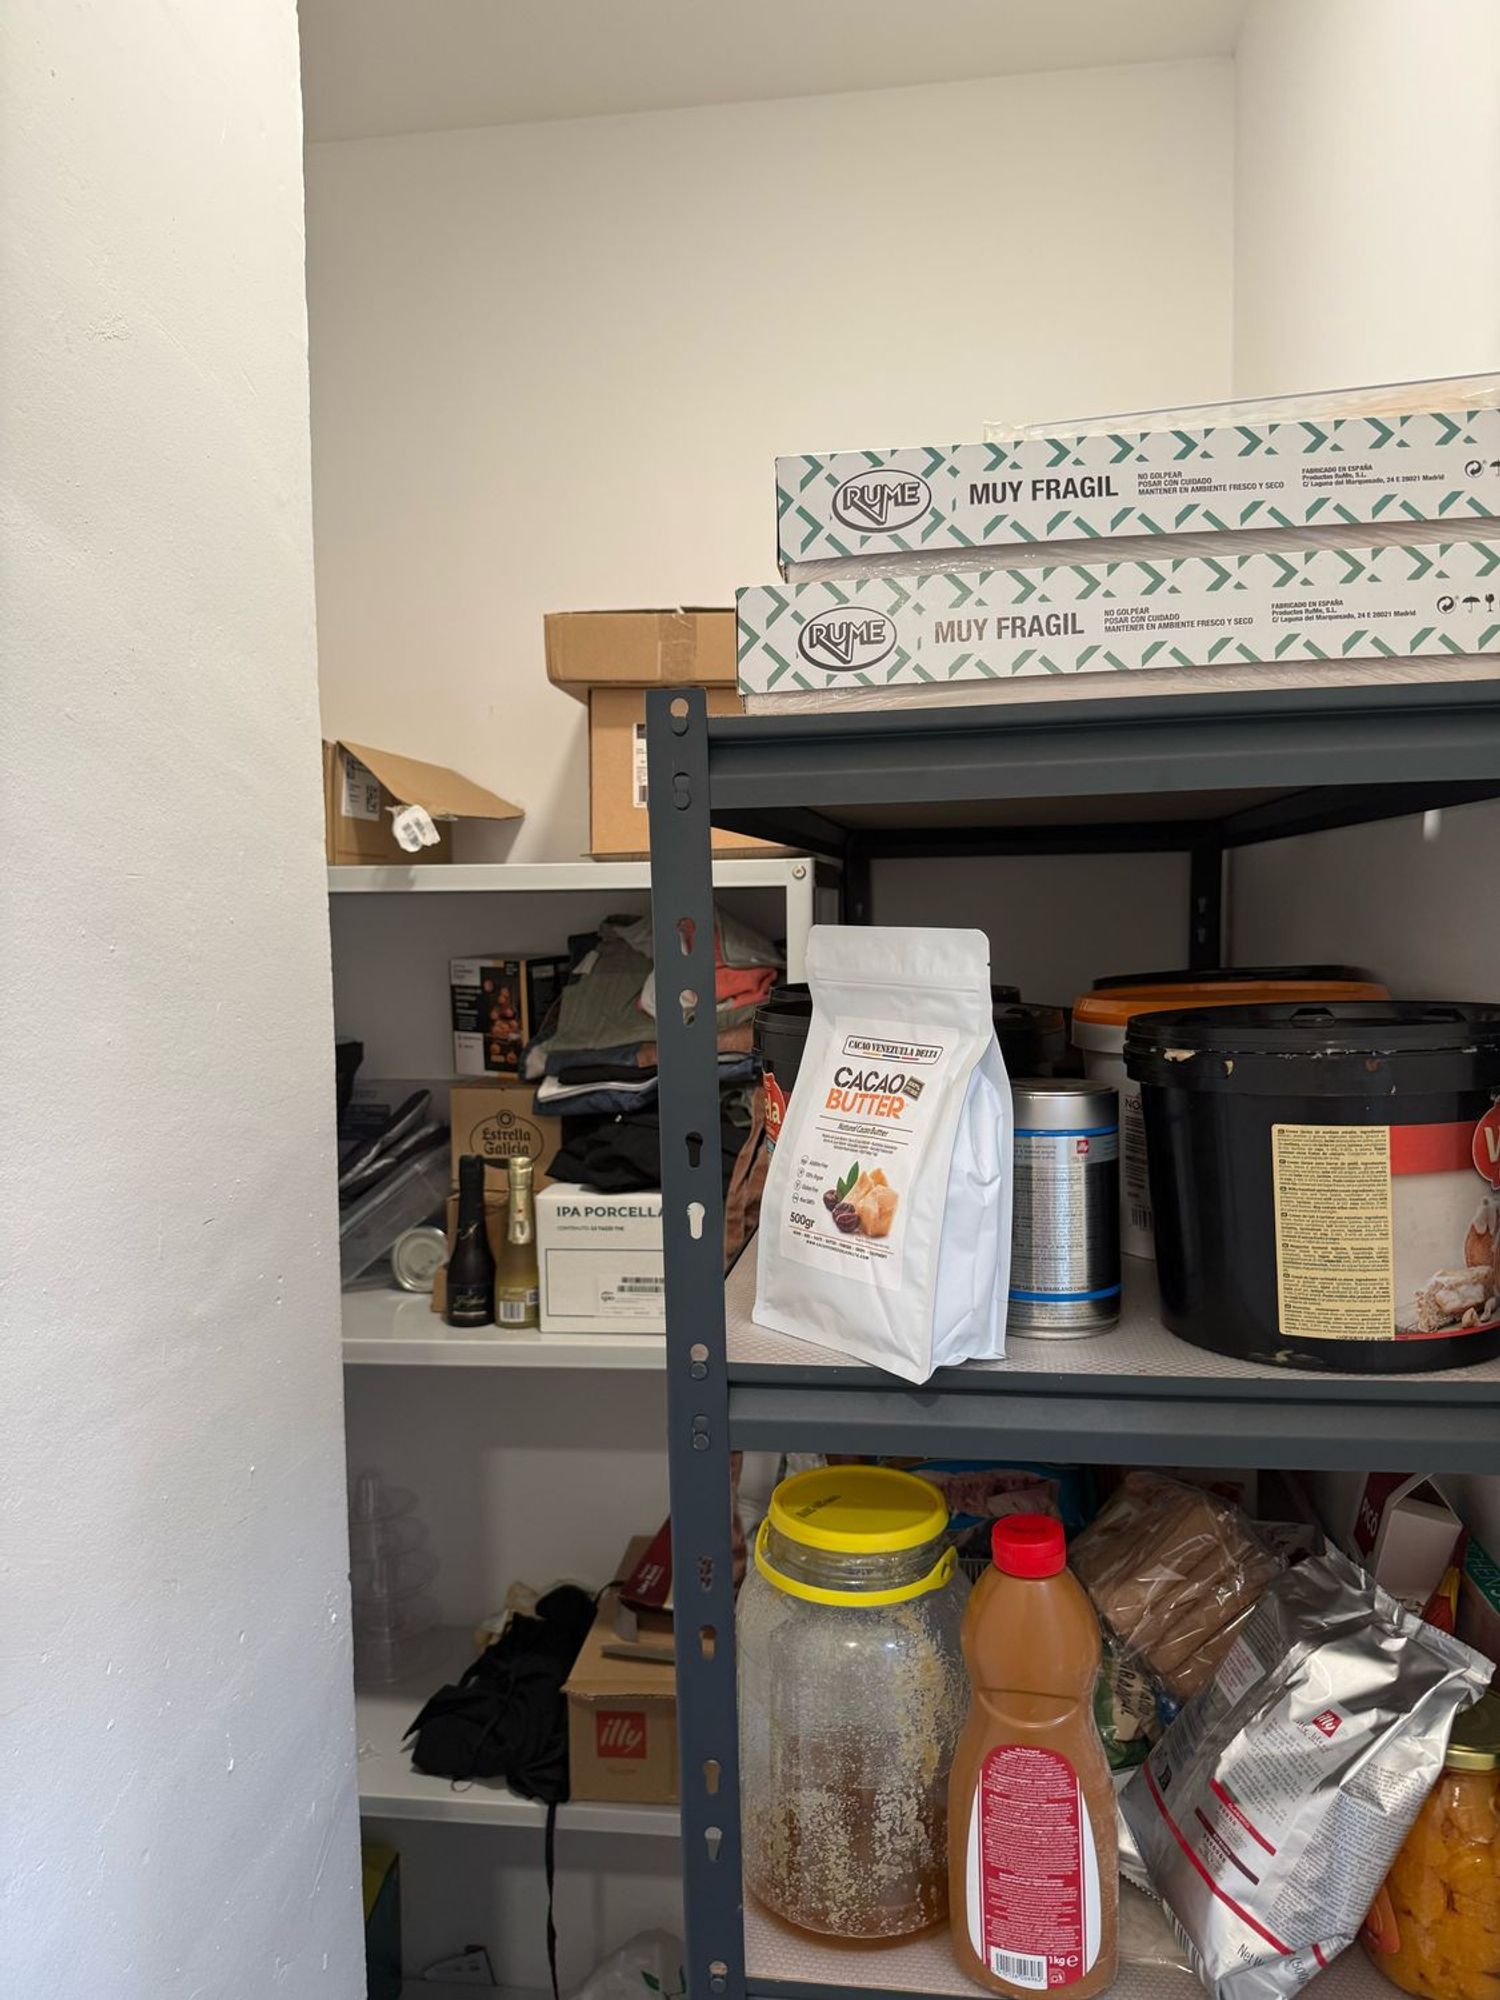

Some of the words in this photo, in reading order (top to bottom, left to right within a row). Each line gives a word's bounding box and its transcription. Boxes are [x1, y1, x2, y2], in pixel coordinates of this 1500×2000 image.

[1137, 480, 1162, 488] POSAR
[1163, 479, 1179, 487] CON
[1180, 477, 1212, 486] CUIDADO
[1149, 471, 1182, 480] GOLPEAR
[969, 480, 1023, 505] MUY
[1031, 475, 1119, 502] FRAGIL
[1138, 487, 1178, 496] MANTENER
[1179, 486, 1189, 494] EN
[1190, 484, 1228, 493] AMBIENTE
[1228, 482, 1257, 491] FRESCO
[1265, 481, 1285, 490] SECO
[842, 481, 920, 526] RUME
[1103, 609, 1115, 617] NO
[1116, 606, 1150, 615] GOLPEAR
[1271, 601, 1307, 609] FABRICADO
[1308, 600, 1317, 608] EN
[1318, 598, 1344, 607] ESPAÑA
[1104, 616, 1129, 625] POSAR
[1130, 615, 1146, 623] CON
[1147, 613, 1180, 622] CUIDADO
[1104, 624, 1145, 633] MANTENER
[1146, 623, 1156, 631] EN
[1157, 620, 1195, 630] AMBIENTE
[1196, 618, 1225, 627] FRESCO
[1233, 617, 1254, 626] SECO
[934, 618, 989, 644] MUY
[996, 613, 1085, 641] FRAGIL
[808, 619, 886, 665] RUME
[848, 1040, 872, 1051] CACAO
[871, 1043, 915, 1057] VENEZUELA
[833, 1066, 906, 1094] CACAO
[825, 1087, 906, 1120] BUTTER
[482, 1127, 531, 1141] Estrella
[484, 1141, 529, 1155] Galicia
[556, 1206, 581, 1217] IPA
[789, 1211, 816, 1229] 500gr
[600, 1718, 644, 1753] illy
[1237, 1943, 1254, 1966] Net
